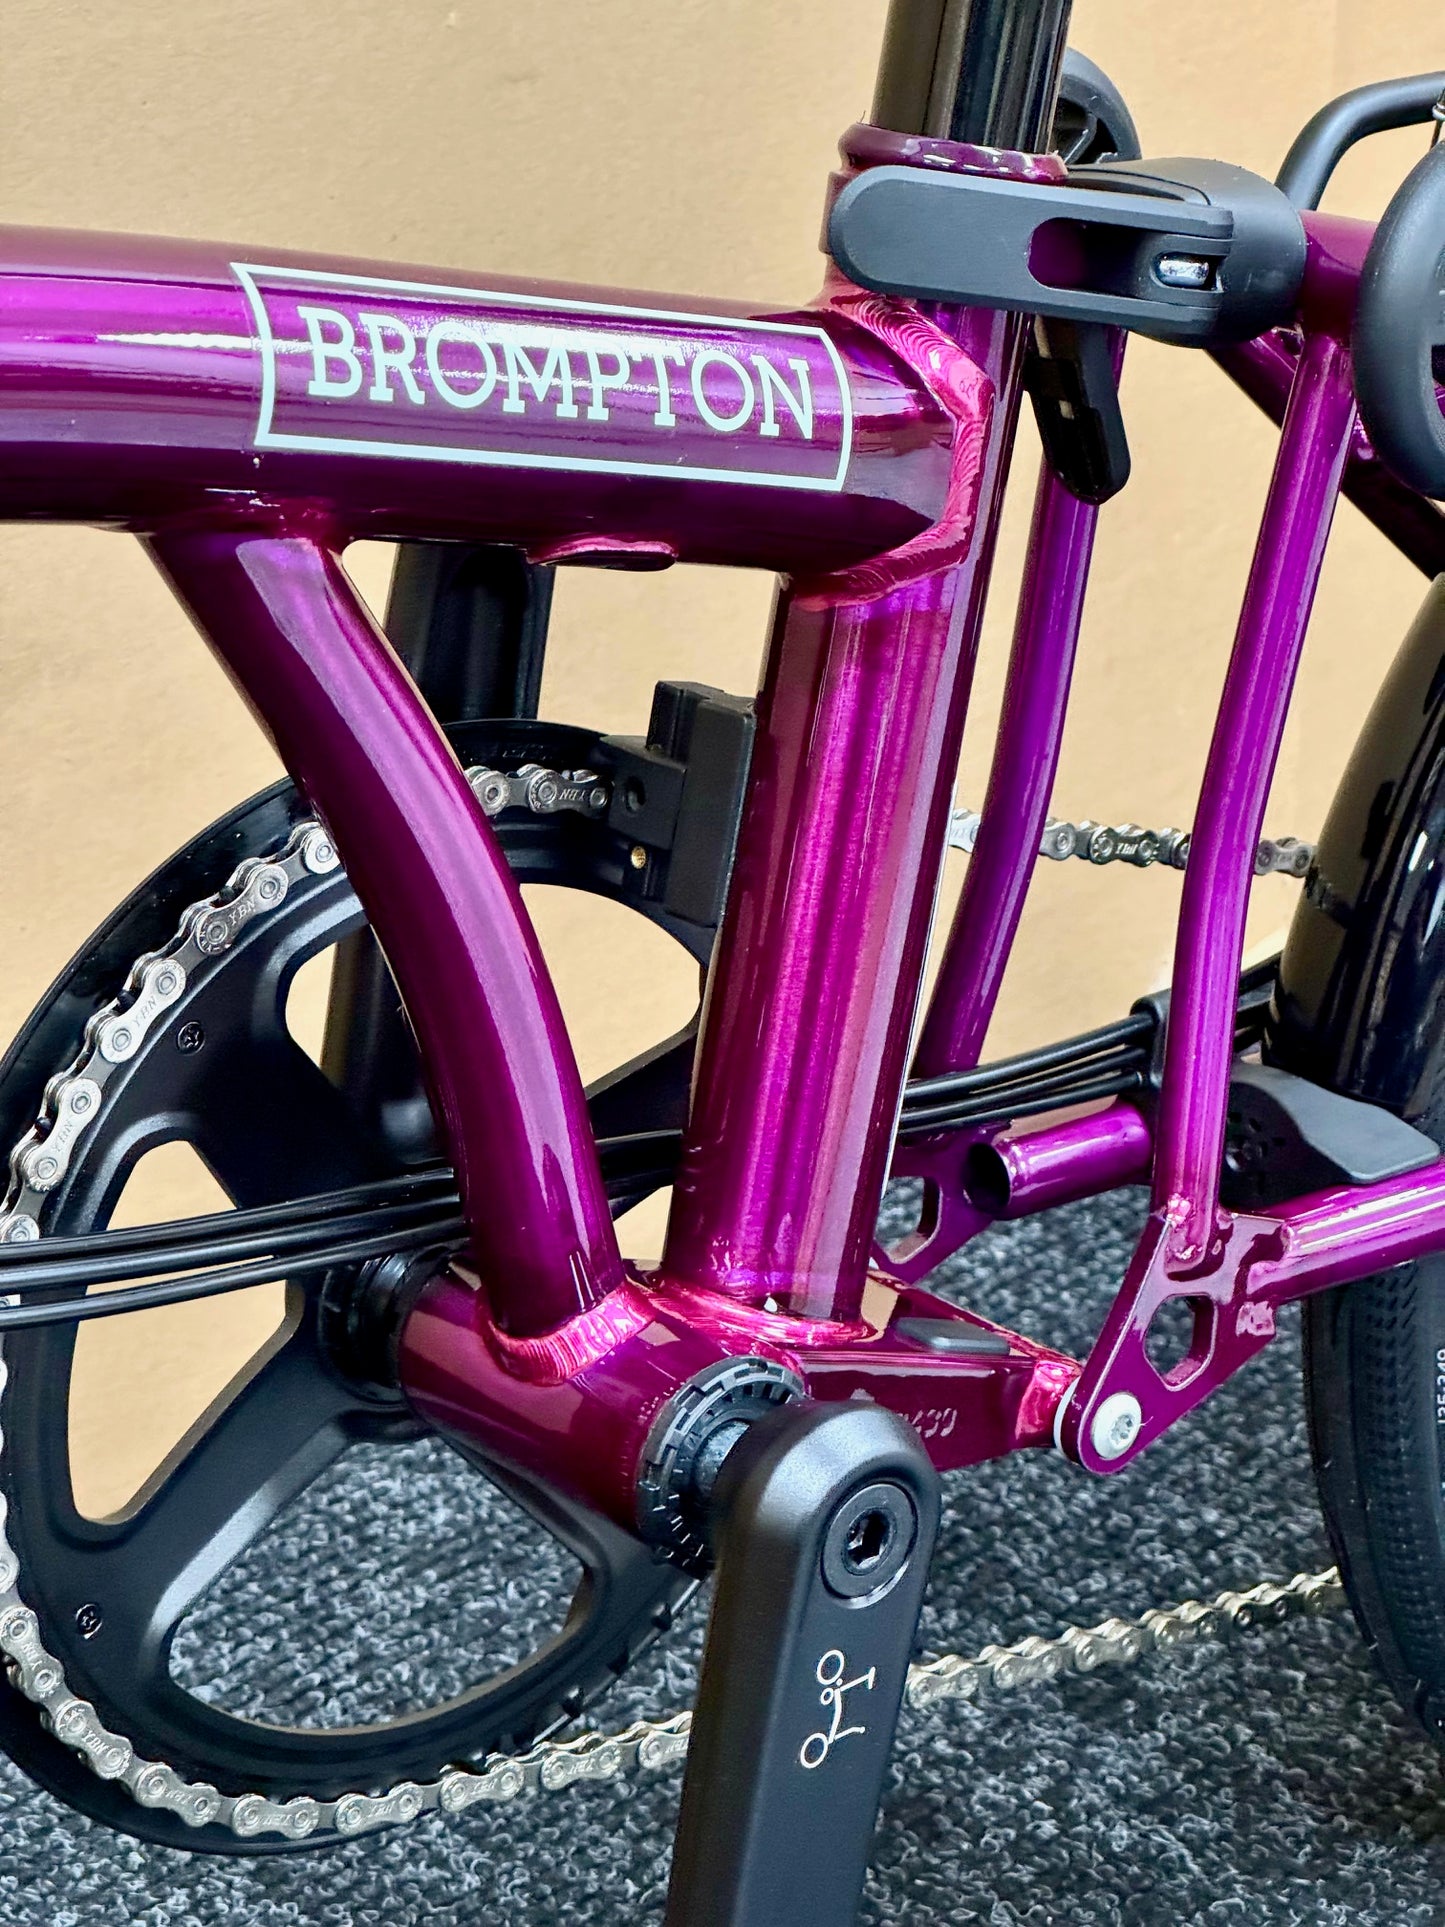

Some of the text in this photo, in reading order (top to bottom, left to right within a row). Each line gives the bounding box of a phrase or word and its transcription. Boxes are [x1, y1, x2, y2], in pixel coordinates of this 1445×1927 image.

[297, 306, 813, 439] BROMPTON
[558, 788, 586, 801] YBN
[229, 896, 255, 926] YBN
[132, 996, 157, 1026] YBN
[82, 1729, 108, 1754] YBN
